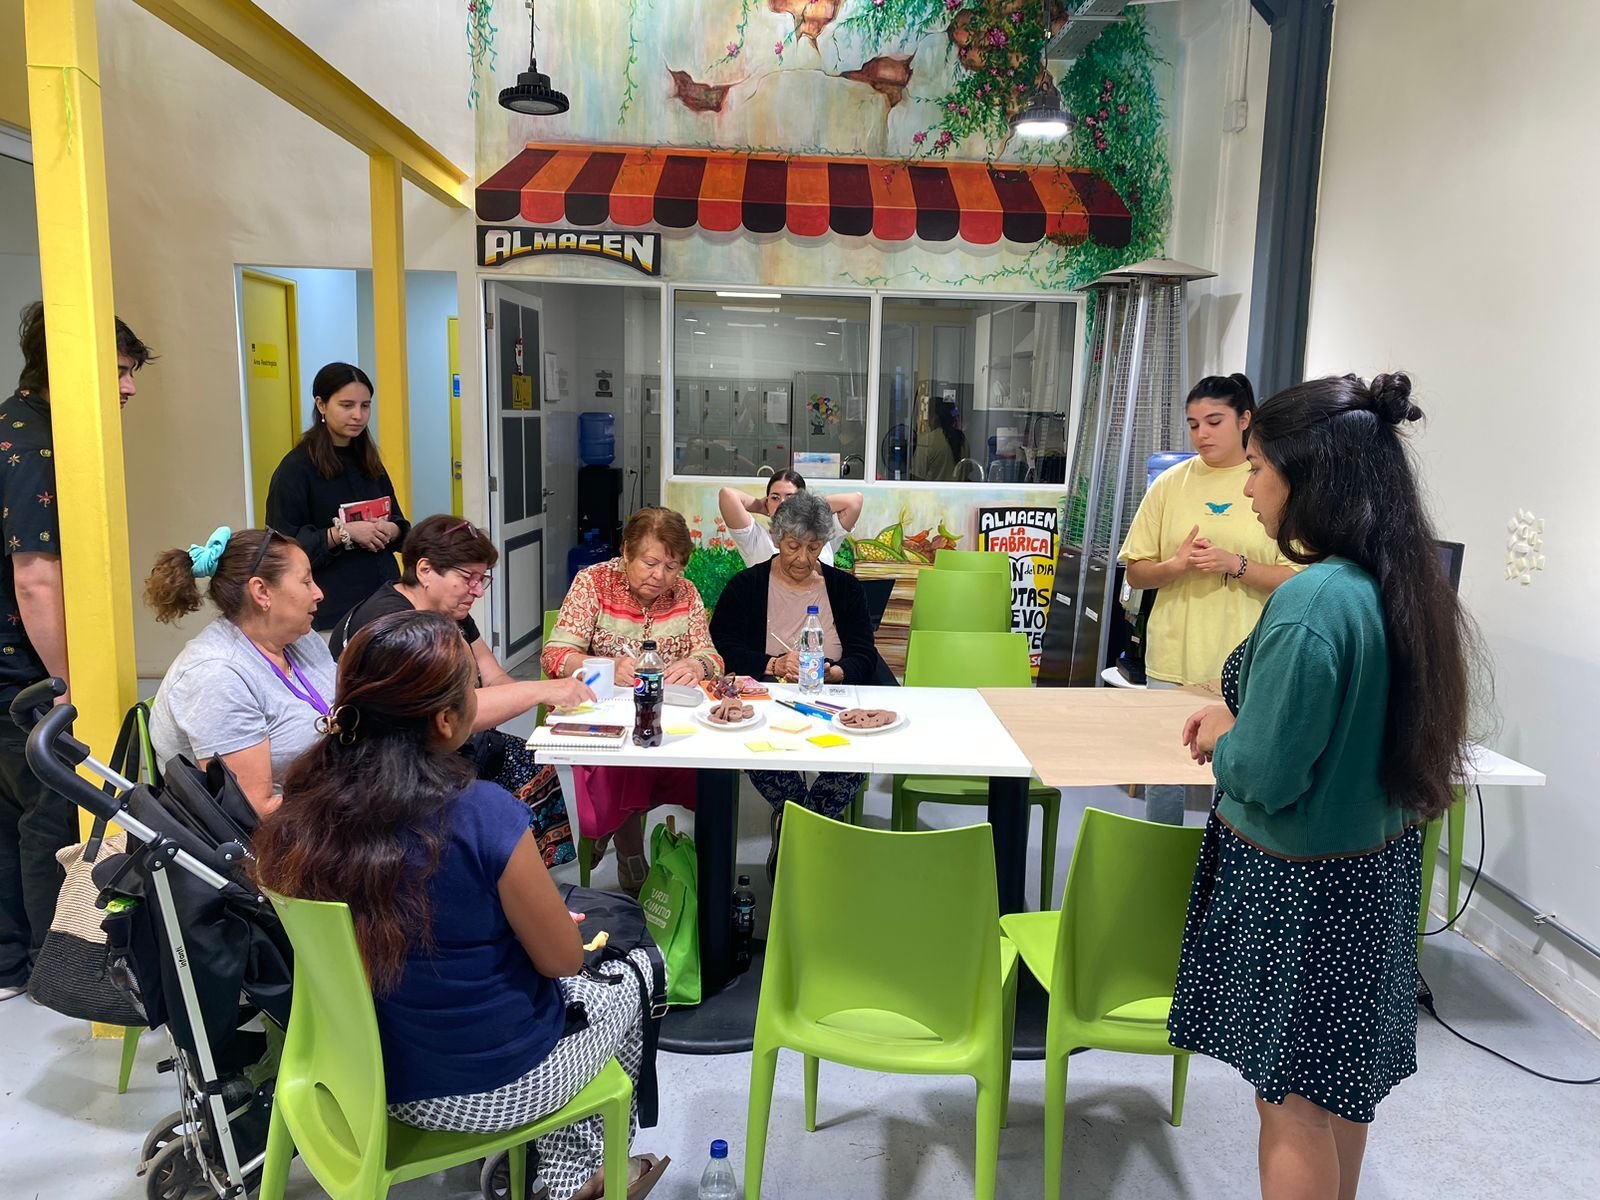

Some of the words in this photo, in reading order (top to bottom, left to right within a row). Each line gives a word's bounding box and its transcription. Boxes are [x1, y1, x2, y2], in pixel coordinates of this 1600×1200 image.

[485, 229, 655, 272] ALMACEN
[981, 511, 1056, 530] ALMACEN
[1009, 527, 1026, 537] LA
[990, 536, 1049, 554] FABRICA
[1037, 564, 1054, 576] DIA
